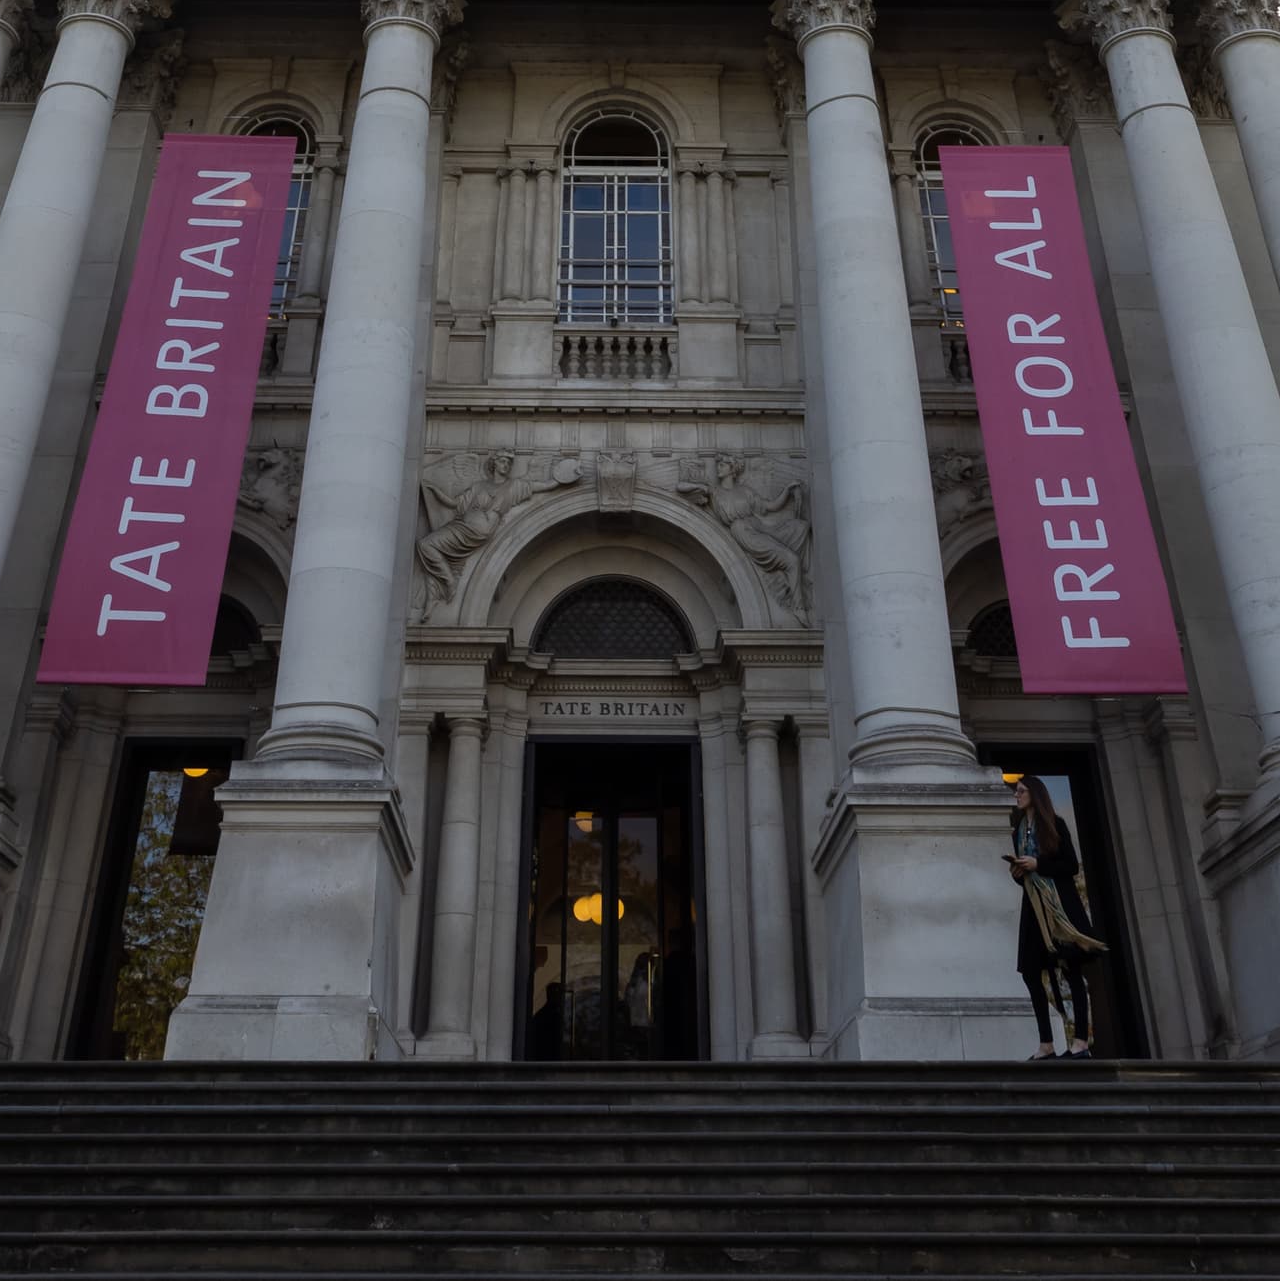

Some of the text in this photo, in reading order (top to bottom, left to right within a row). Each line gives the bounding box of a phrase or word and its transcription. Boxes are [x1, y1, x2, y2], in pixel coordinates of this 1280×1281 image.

[97, 170, 252, 637] TATE BRITAIN
[984, 175, 1131, 649] FREE FOR ALL
[540, 701, 686, 717] TATE BRITAIN
